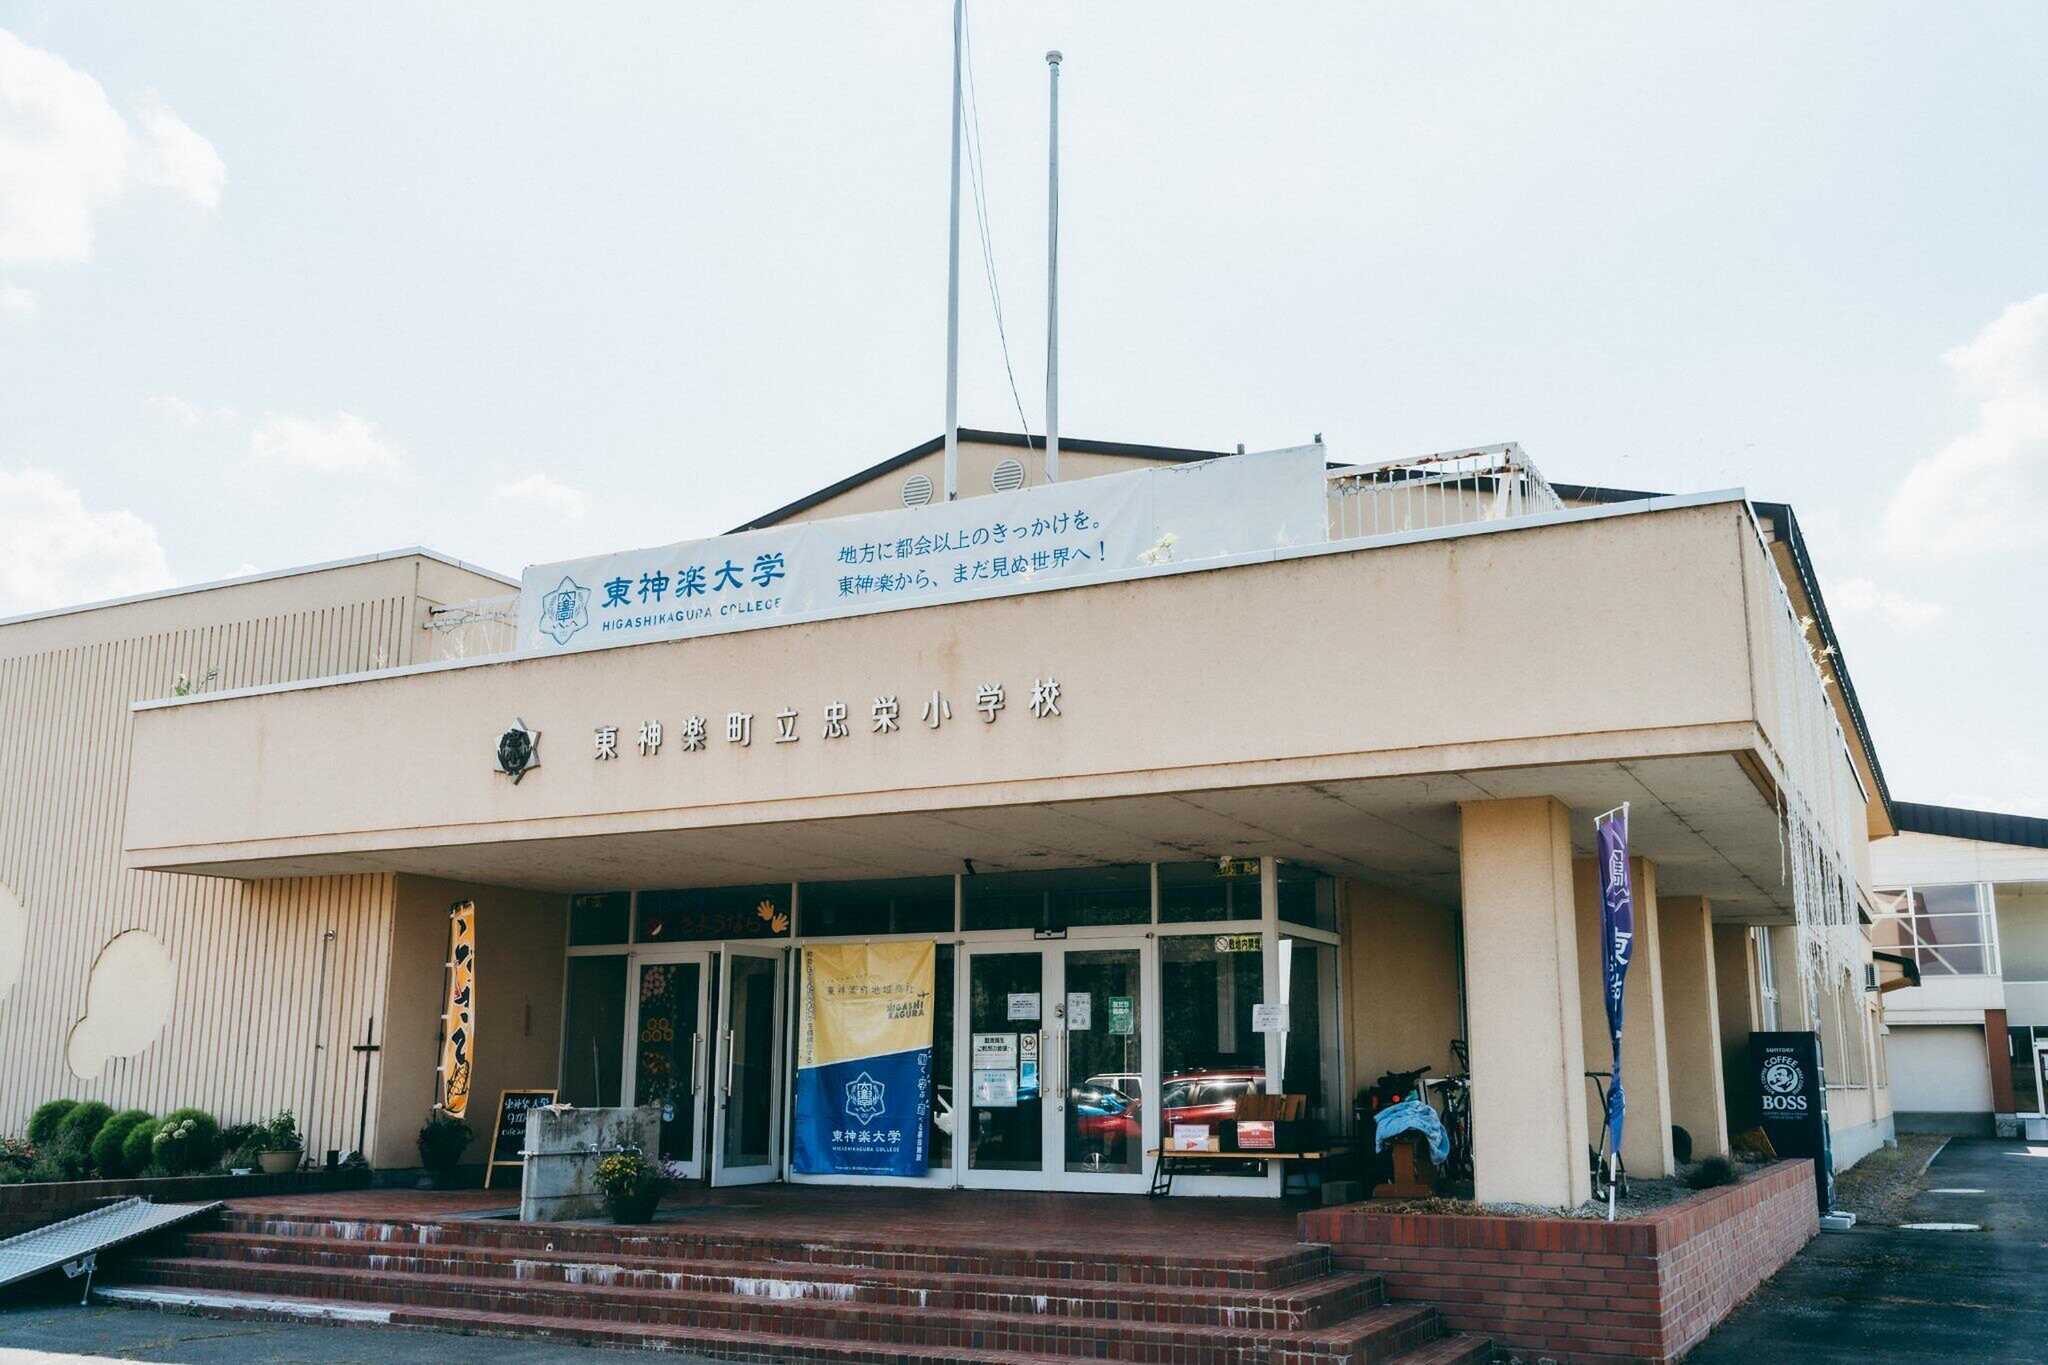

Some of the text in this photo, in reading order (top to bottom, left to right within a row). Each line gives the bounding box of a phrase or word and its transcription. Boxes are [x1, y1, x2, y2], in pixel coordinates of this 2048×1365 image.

[837, 510, 1101, 564] 地方に都会以上のきっかけを。
[601, 552, 786, 609] 東神楽大学
[593, 677, 1062, 761] 東神楽町立忠栄小学校
[1764, 1055, 1799, 1068] COFFEE
[1762, 1095, 1808, 1110] BOSS
[831, 1129, 902, 1144] 東神楽大学
